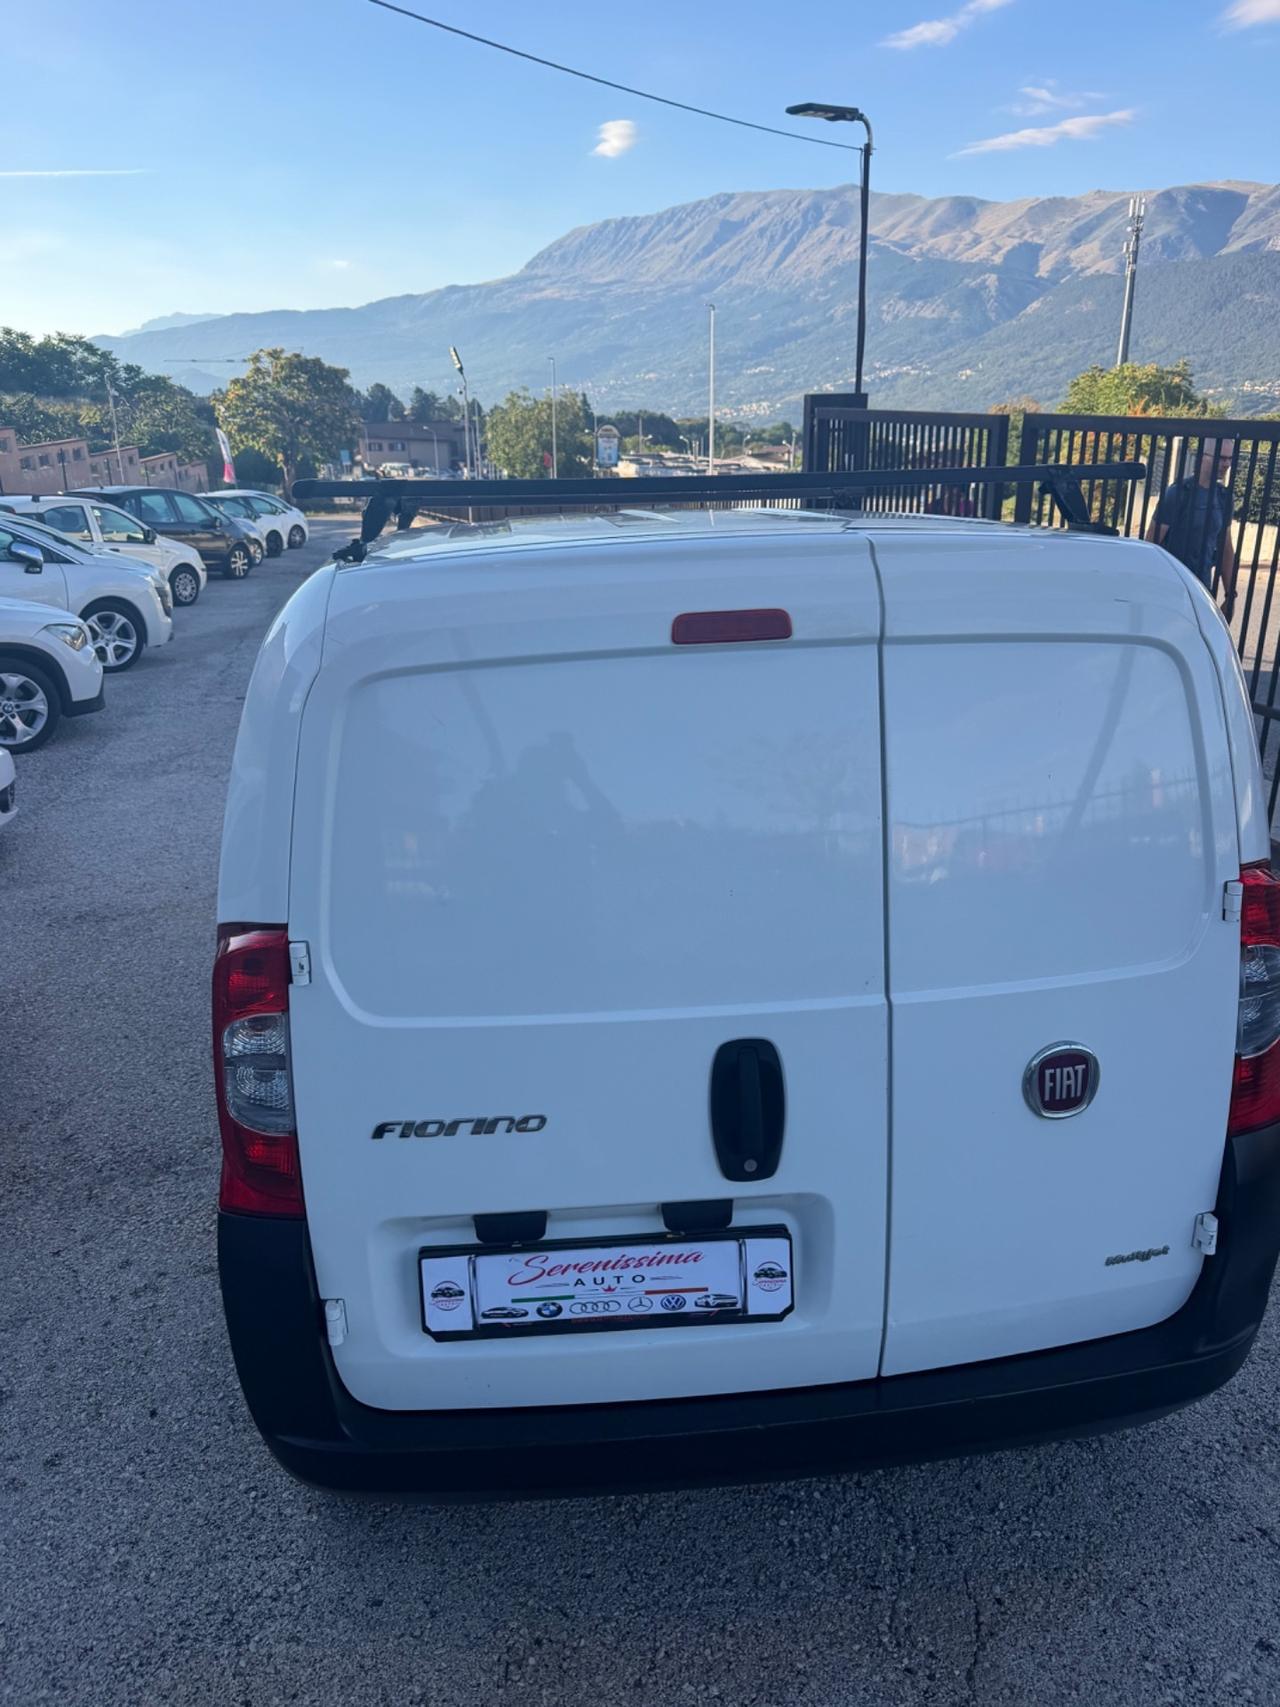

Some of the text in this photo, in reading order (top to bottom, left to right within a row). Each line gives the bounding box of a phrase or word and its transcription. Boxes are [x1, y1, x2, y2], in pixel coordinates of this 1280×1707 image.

[1044, 1064, 1086, 1101] FIAT
[507, 1250, 705, 1287] Serenissima
[573, 1274, 646, 1288] AUTO
